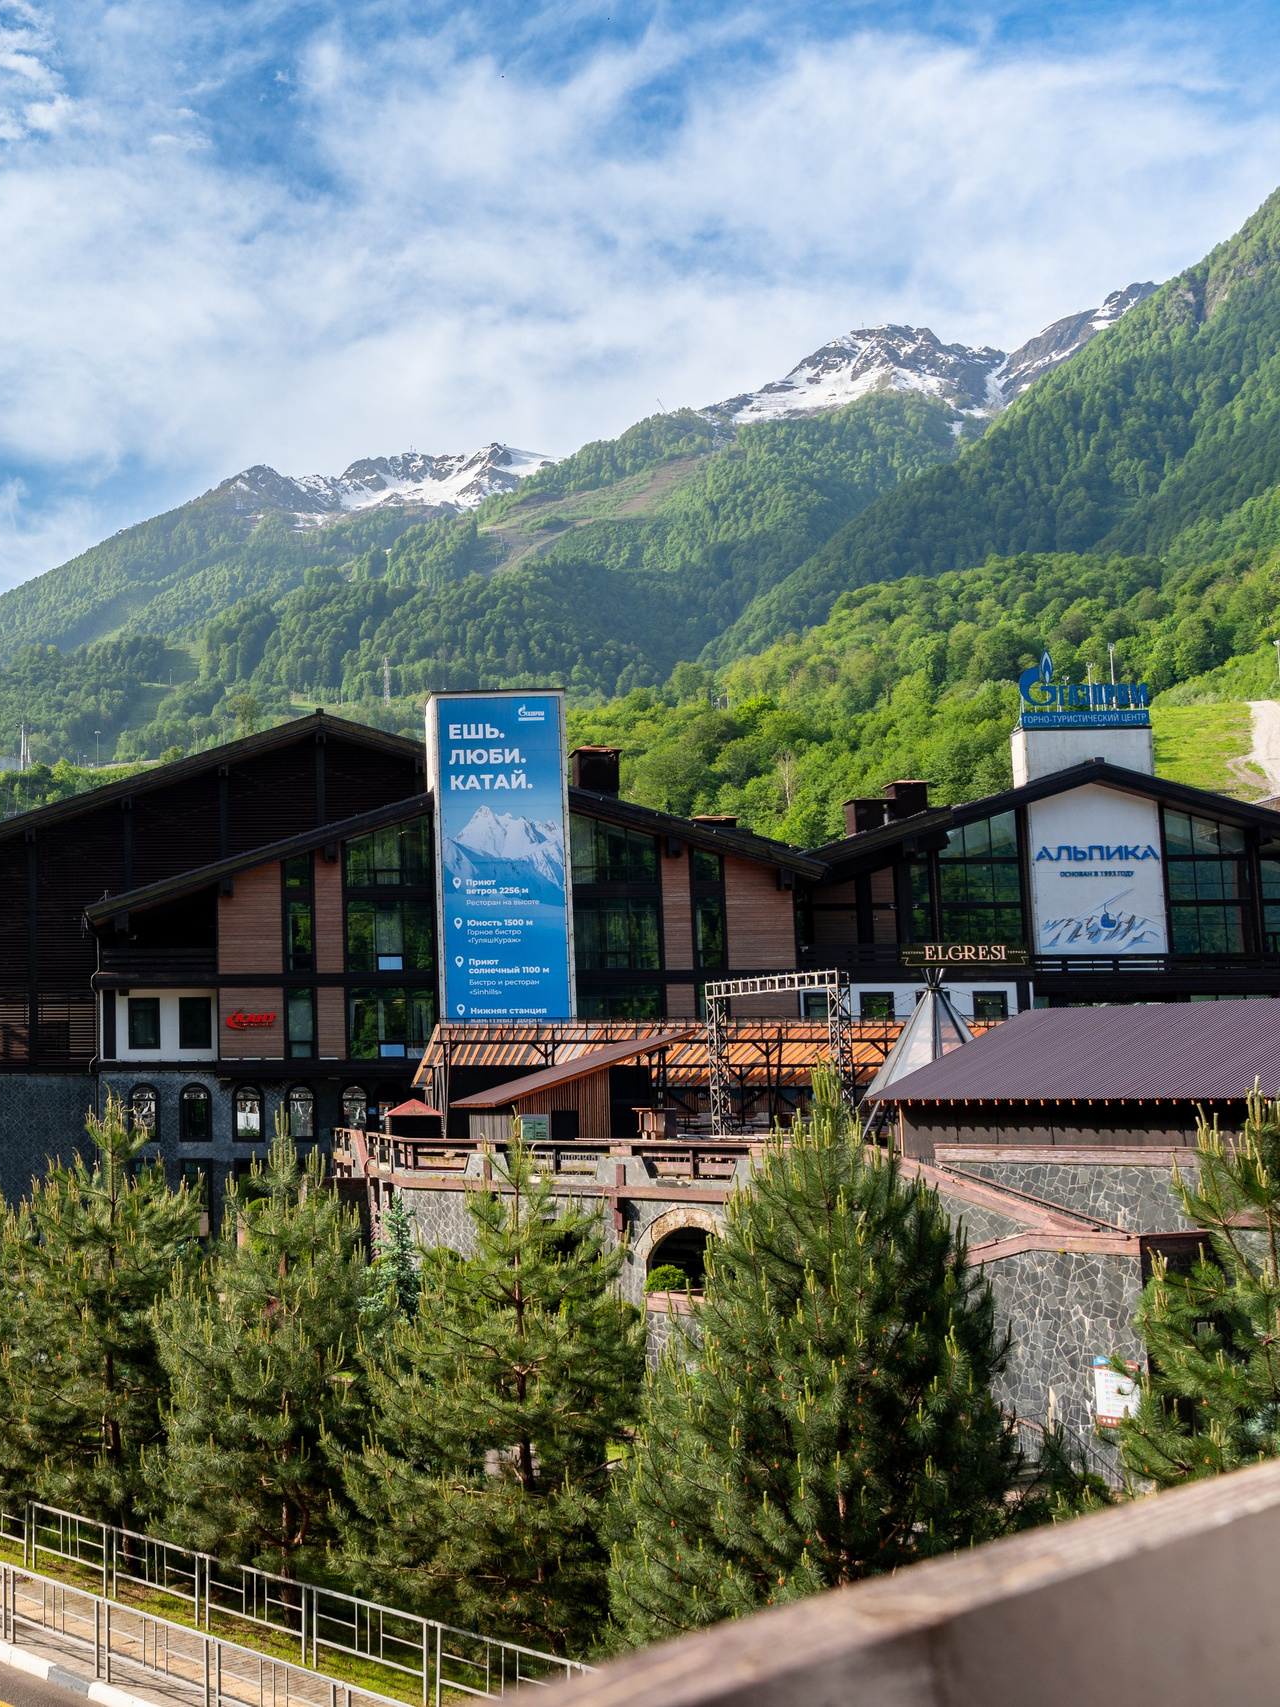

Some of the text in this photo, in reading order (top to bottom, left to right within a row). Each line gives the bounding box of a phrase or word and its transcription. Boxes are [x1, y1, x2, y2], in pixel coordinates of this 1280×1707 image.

[1024, 713, 1146, 724] ГОРНО-ТУРИСТИЧЕСКИЙ ЦЕНТР
[448, 724, 506, 740] ЕШЬ.
[448, 748, 527, 765] ЛЮБИ.
[450, 770, 534, 790] КАТАЙ.
[1036, 844, 1160, 861] АЛЬПИКА
[466, 878, 496, 887] Приют
[466, 888, 497, 896] ветров
[495, 928, 522, 936] бистро
[924, 945, 1007, 960] ELGRESI
[468, 958, 499, 967] Приют
[234, 1012, 278, 1022] КАНТ
